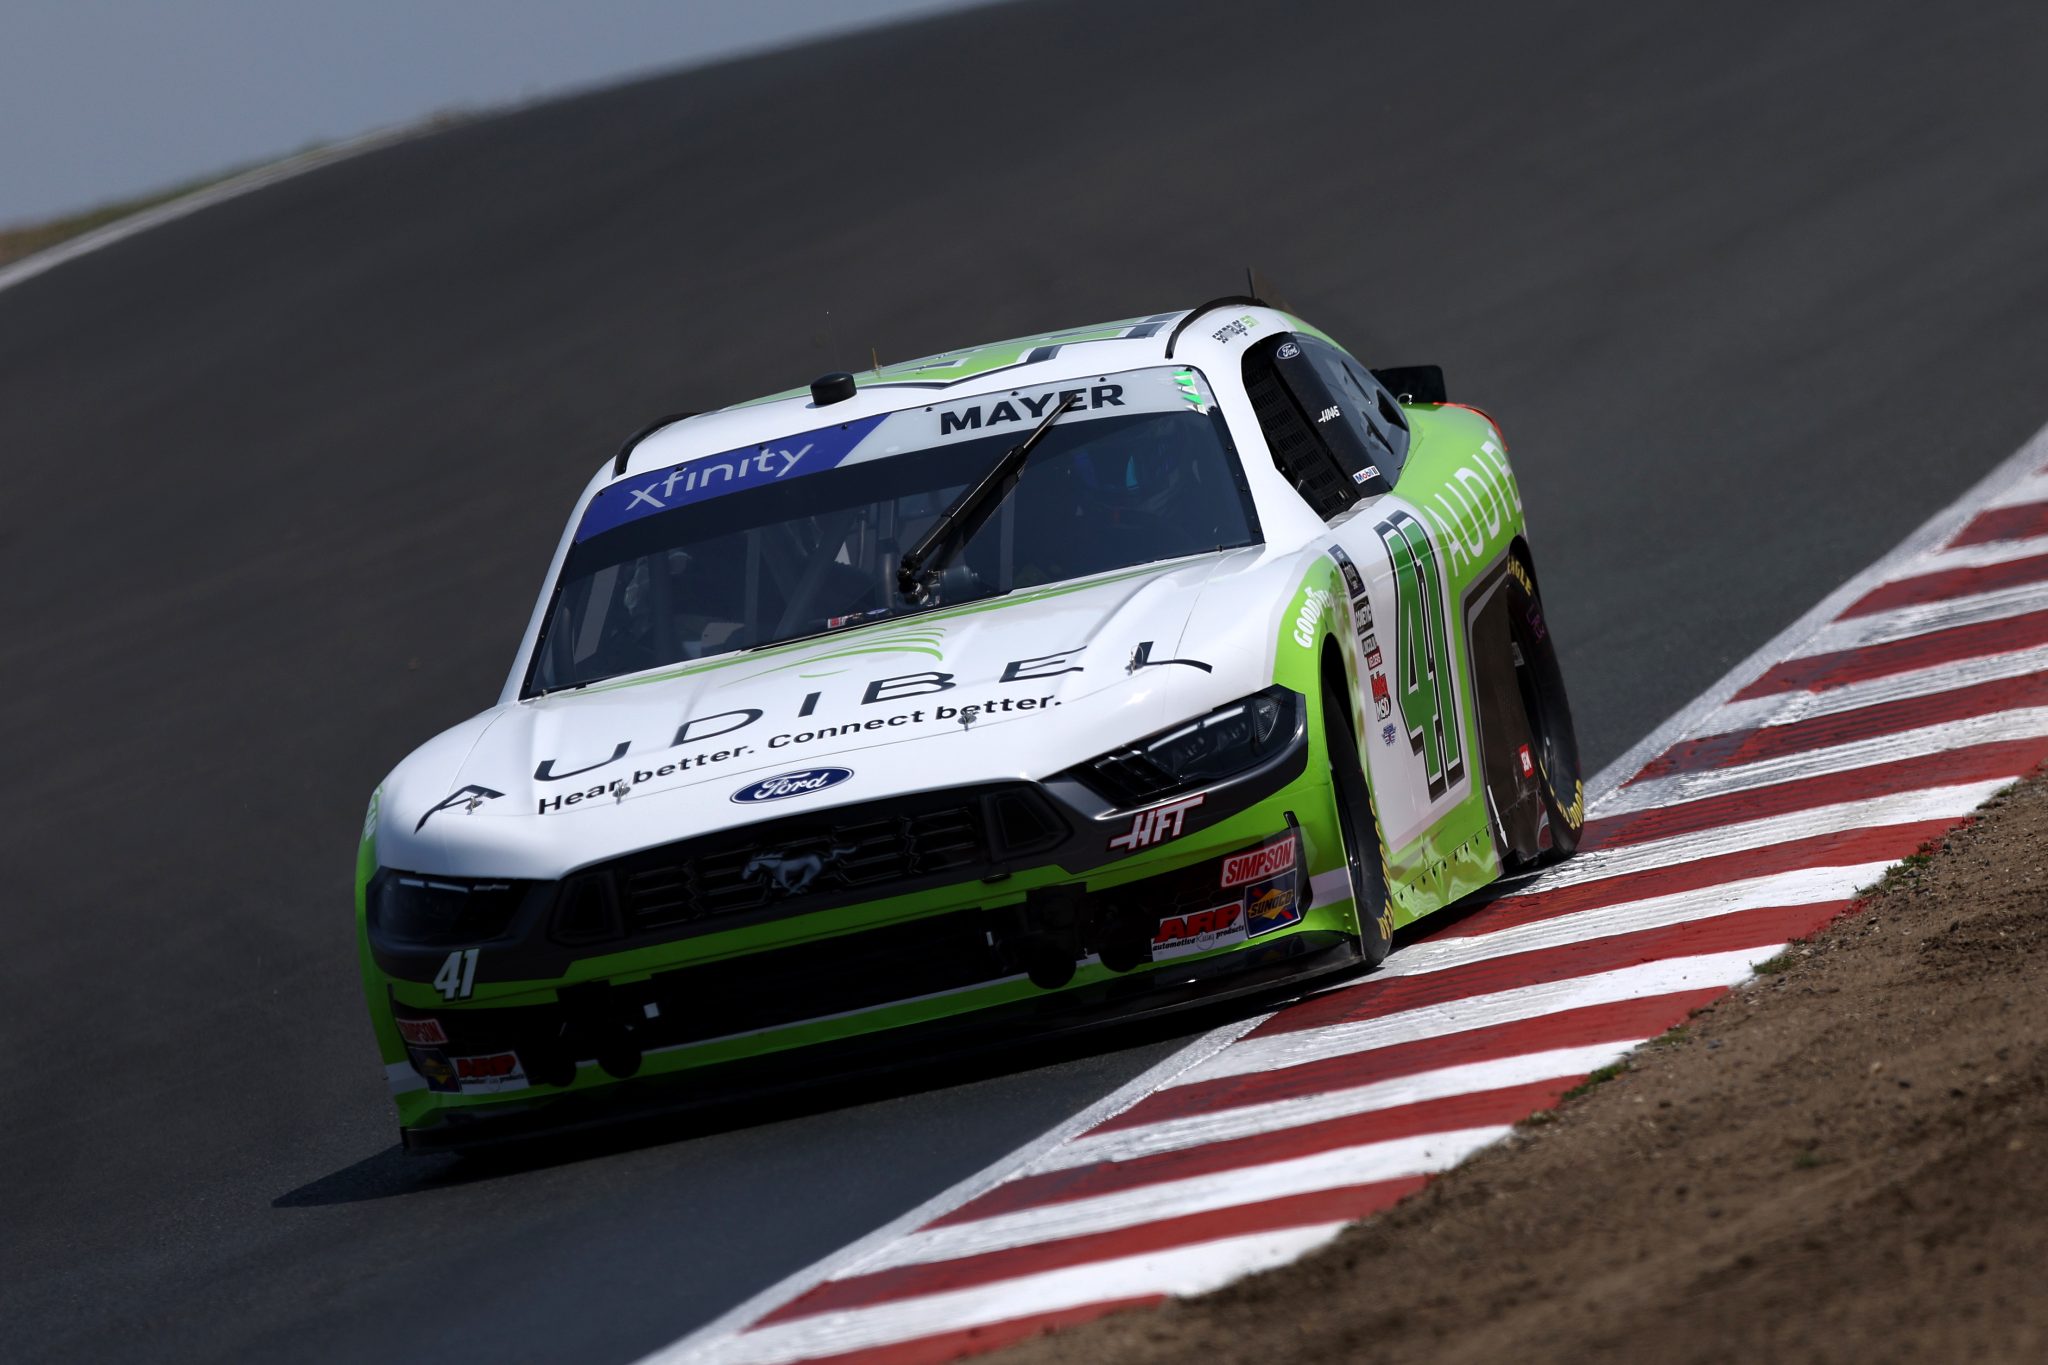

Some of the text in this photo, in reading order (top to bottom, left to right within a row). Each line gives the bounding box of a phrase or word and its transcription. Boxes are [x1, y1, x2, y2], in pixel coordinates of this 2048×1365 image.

[940, 384, 1125, 436] MAYER
[624, 444, 815, 511] xfinity
[1354, 467, 1372, 483] Mobil
[1373, 509, 1466, 804] 41
[416, 641, 1213, 834] AUDIBEL
[538, 695, 1062, 815] Hear better. Connect better.
[753, 771, 830, 800] Ford
[1225, 840, 1292, 885] SIMPSON
[1152, 903, 1242, 944] ARP
[1250, 891, 1293, 917] SUNOCO
[1152, 937, 1196, 951] automotive
[1215, 925, 1245, 939] products
[433, 948, 480, 1000] 41
